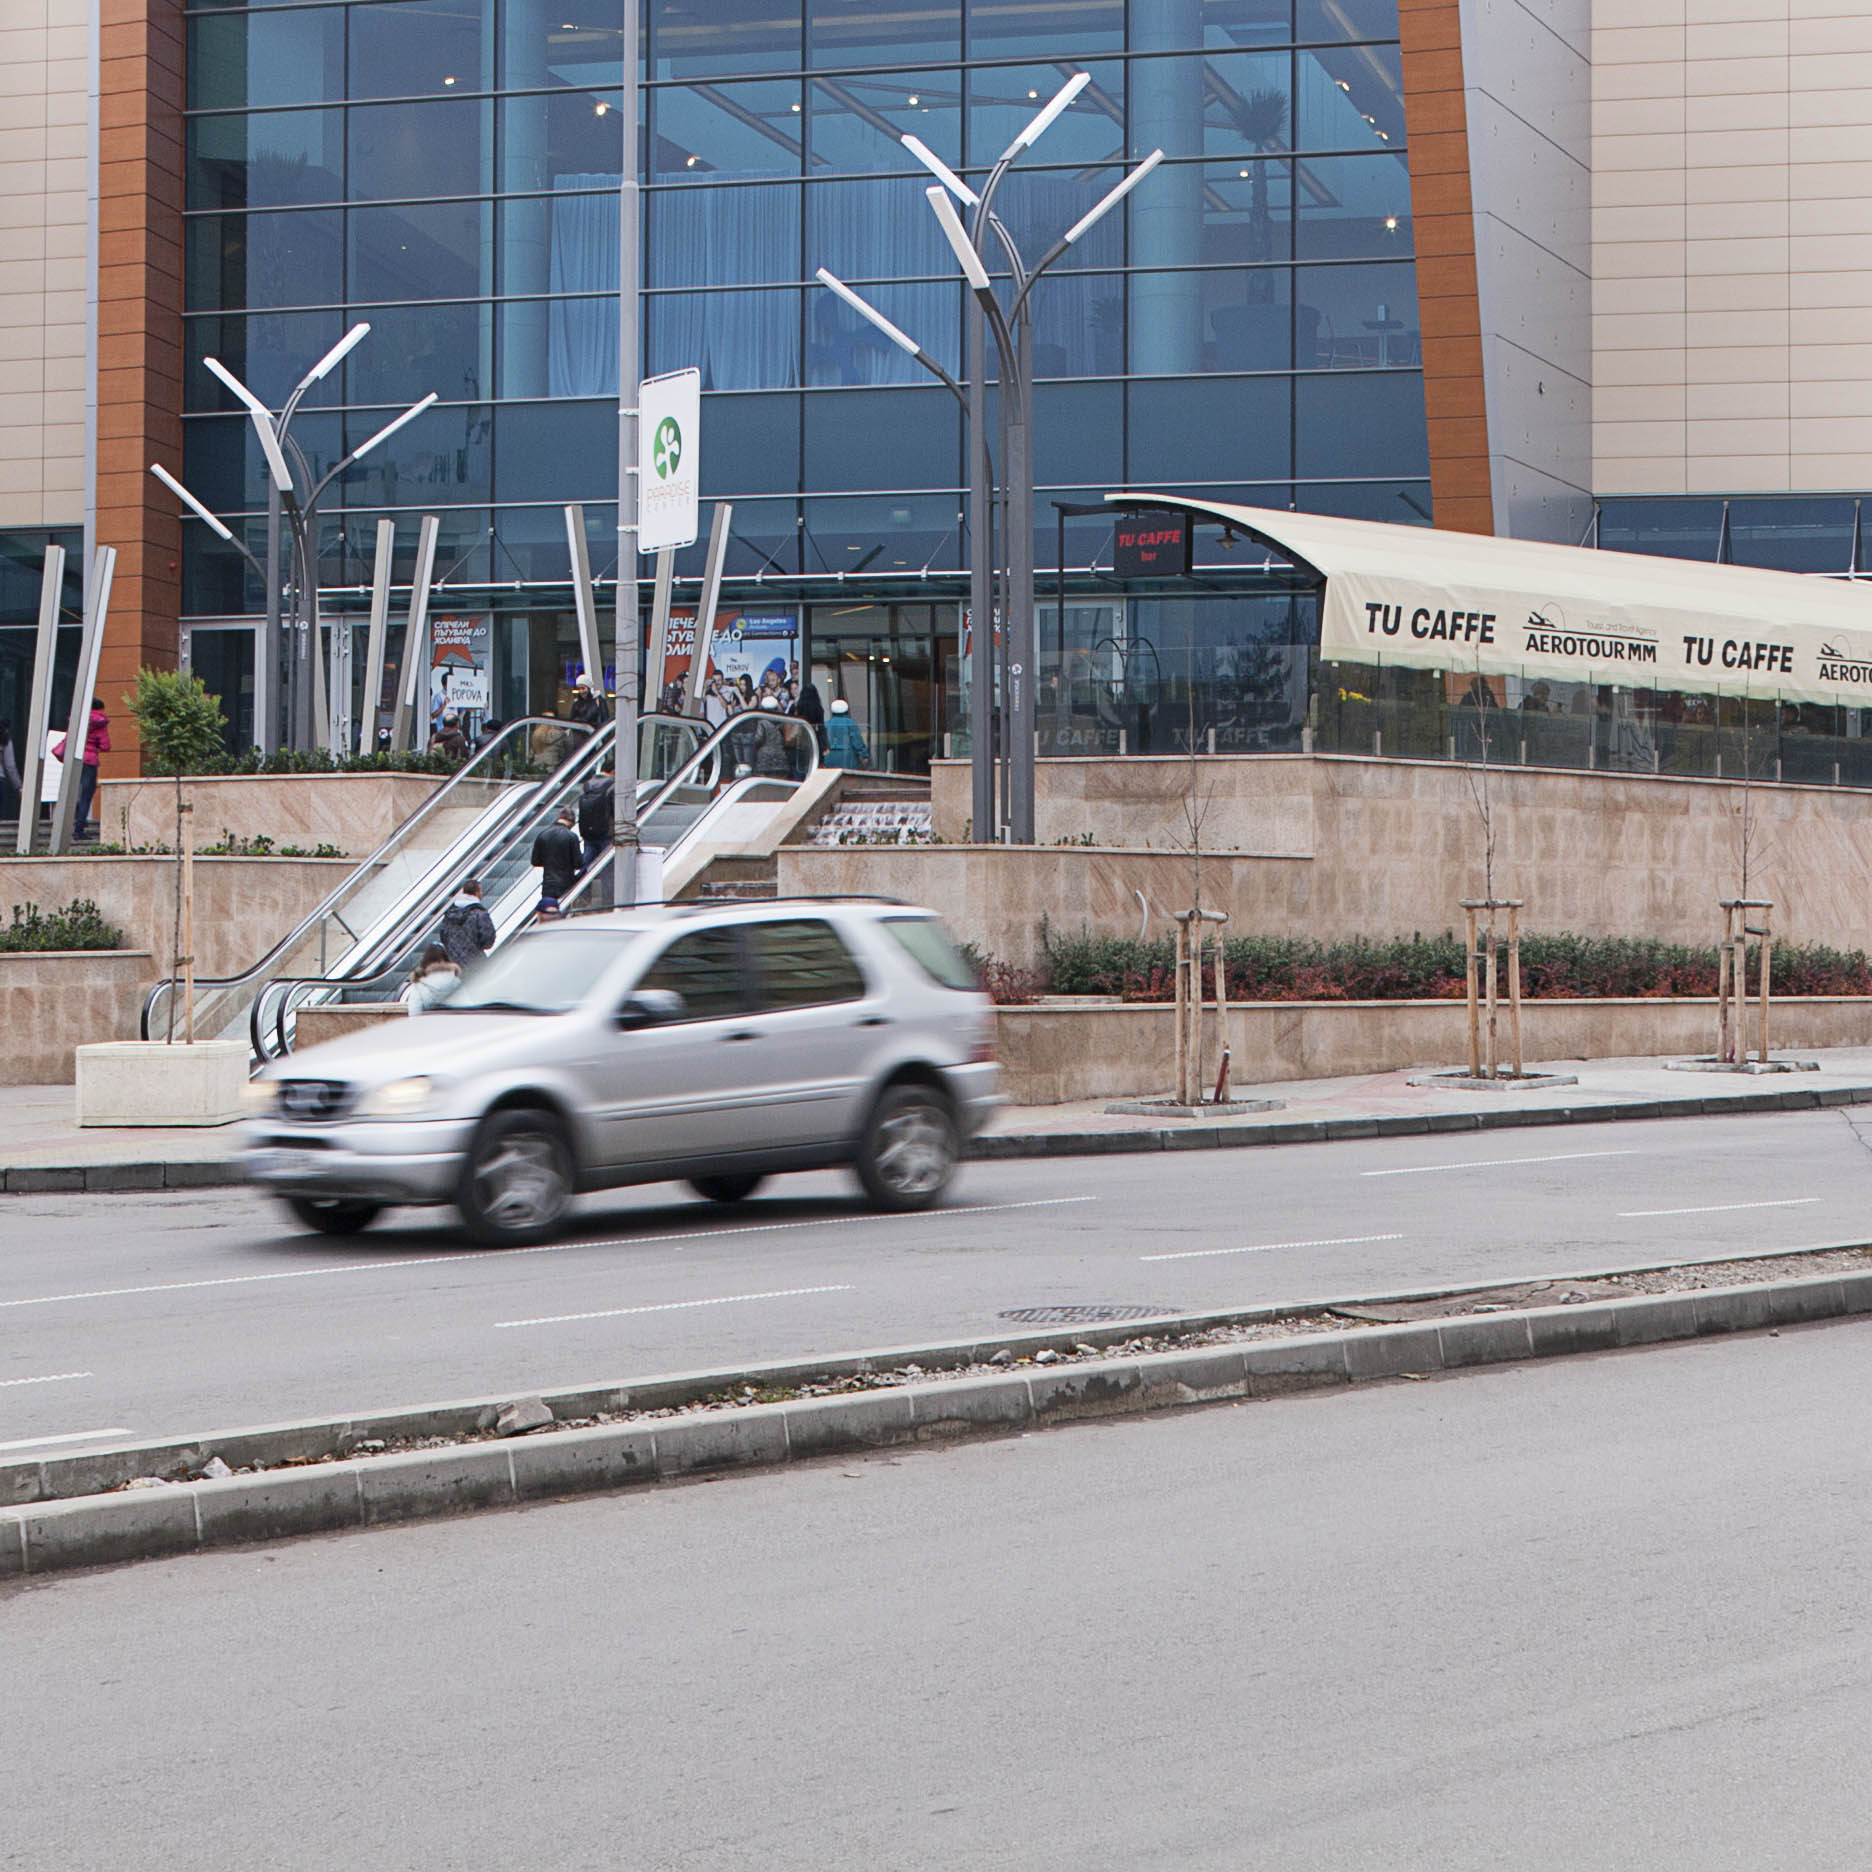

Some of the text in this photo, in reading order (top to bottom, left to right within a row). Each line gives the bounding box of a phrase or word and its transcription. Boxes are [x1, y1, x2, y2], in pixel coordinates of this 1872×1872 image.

[1119, 529, 1181, 547] TU CAFFE
[1365, 602, 1496, 644] TU CAFFE
[719, 629, 742, 642] ДО
[1525, 633, 1657, 663] AEROTOUR MM
[1683, 636, 1794, 673] TU CAFFE
[452, 687, 482, 702] POPOVA
